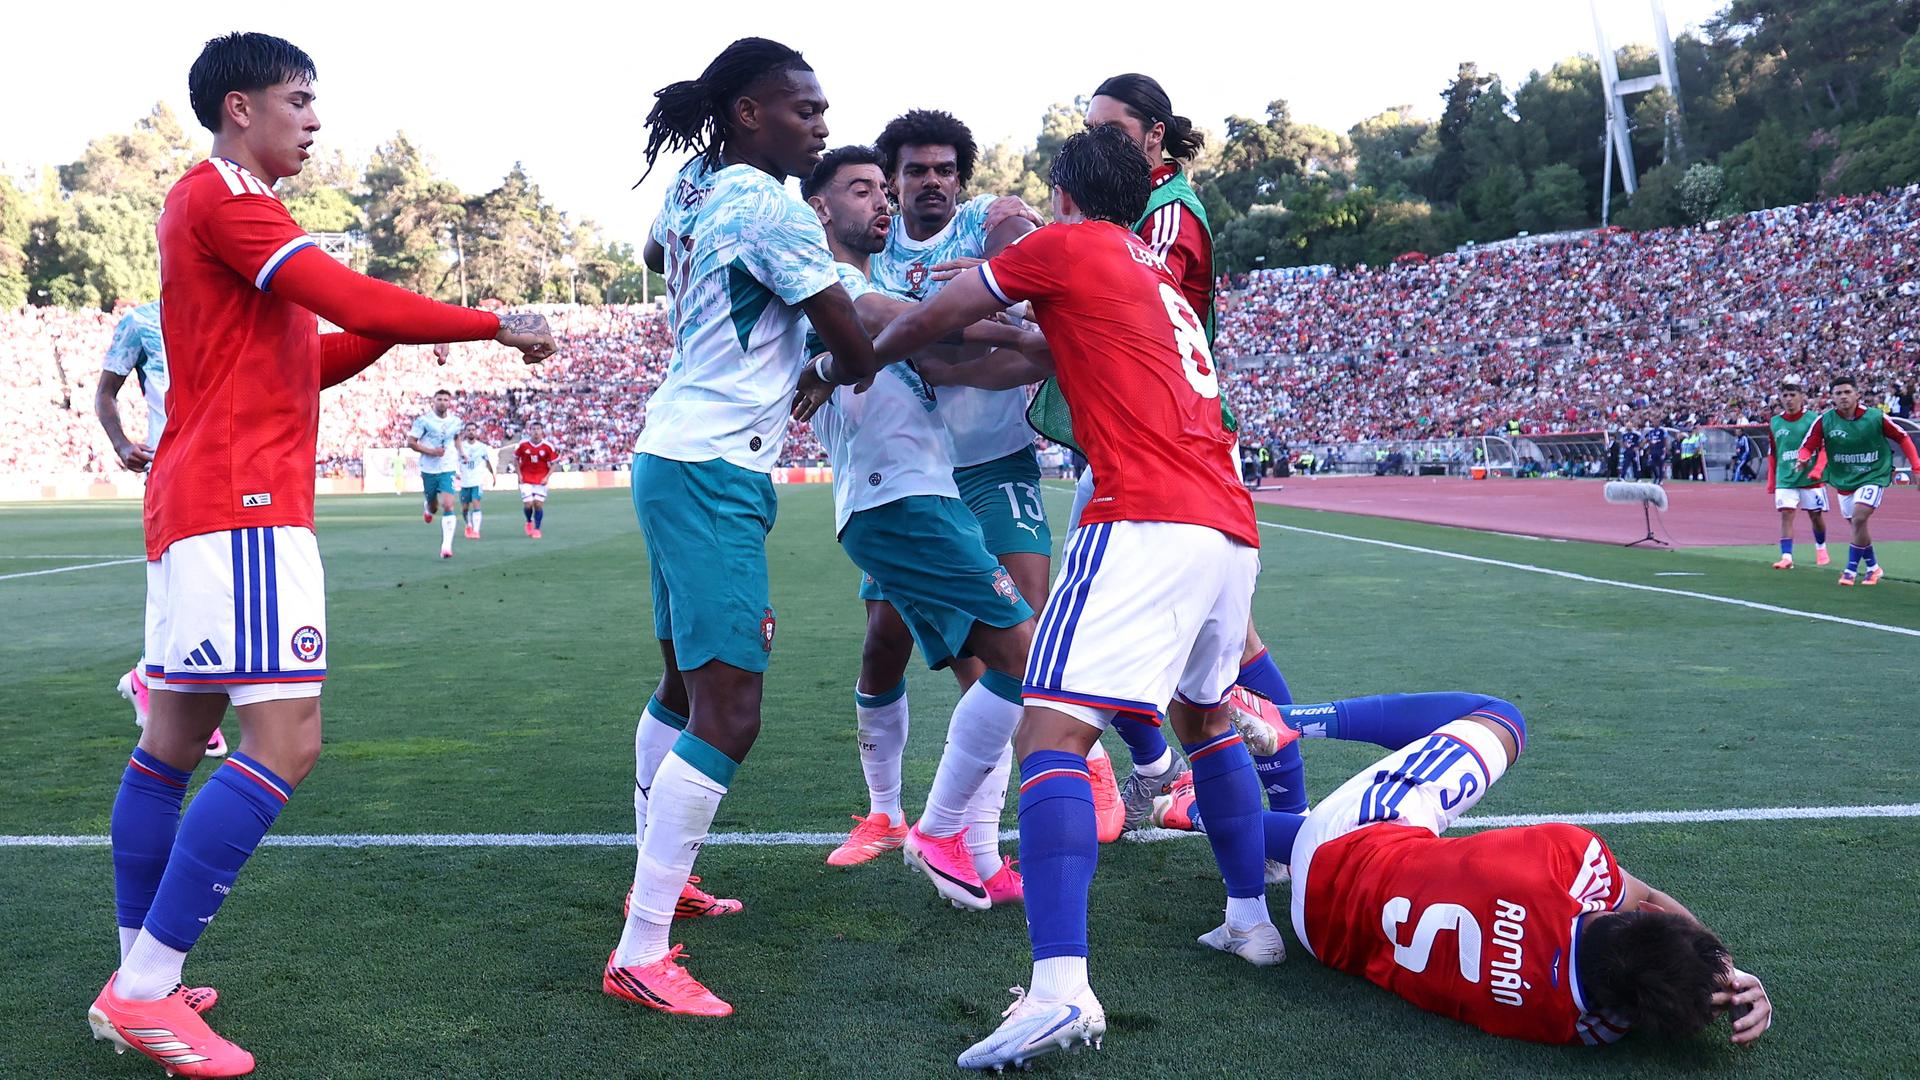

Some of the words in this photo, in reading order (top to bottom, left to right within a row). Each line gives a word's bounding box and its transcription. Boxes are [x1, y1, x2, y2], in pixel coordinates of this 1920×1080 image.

[1159, 283, 1219, 399] 8
[1834, 450, 1879, 463] #FOOTBALL
[998, 482, 1044, 521] 13
[1860, 487, 1875, 501] 13
[1381, 896, 1482, 984] 5
[1490, 898, 1532, 1008] ROMÁN
